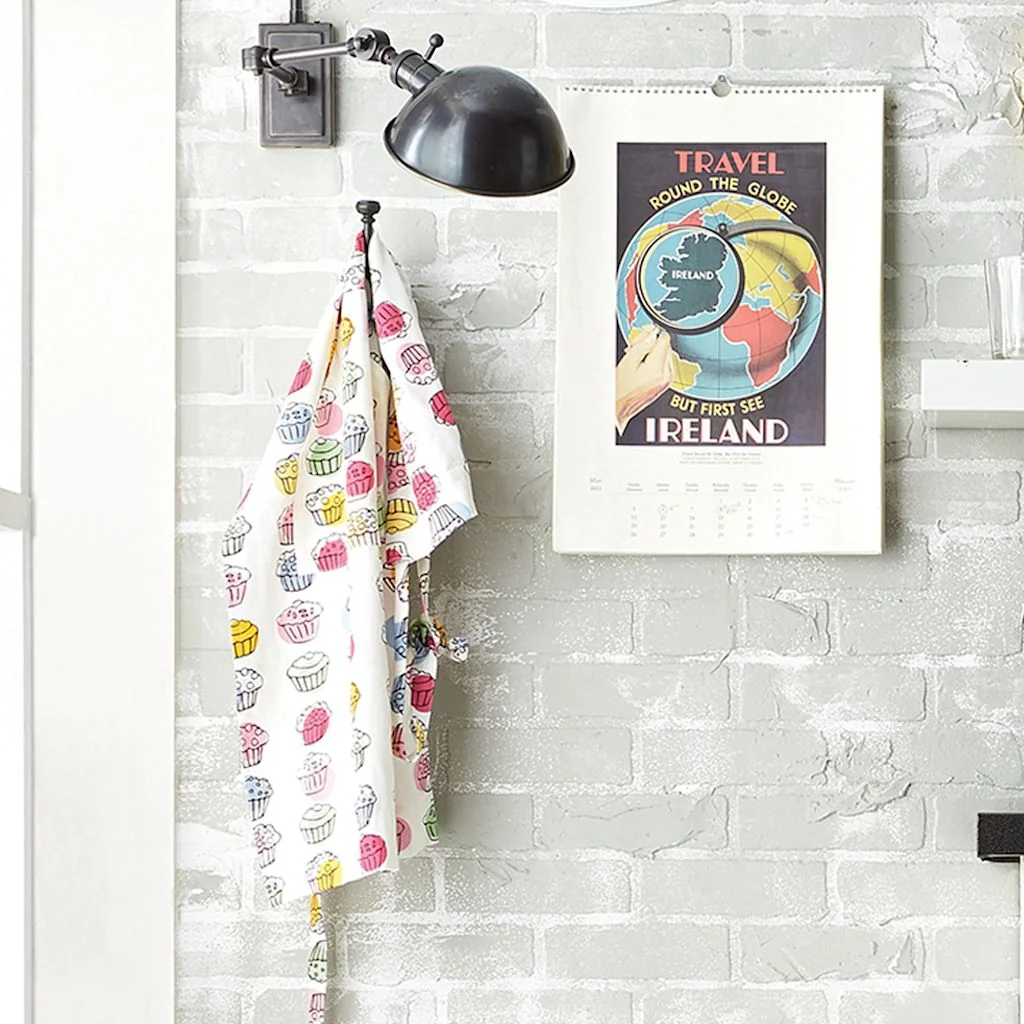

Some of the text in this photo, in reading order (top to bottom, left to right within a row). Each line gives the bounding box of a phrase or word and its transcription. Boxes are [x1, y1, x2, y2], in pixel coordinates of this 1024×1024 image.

[674, 150, 785, 175] TRAVEL
[648, 177, 799, 216] ROUND THE GLOBE
[671, 270, 715, 281] IRELAND
[670, 394, 766, 417] BUT FIRST SEE
[645, 417, 790, 445] IRELAND
